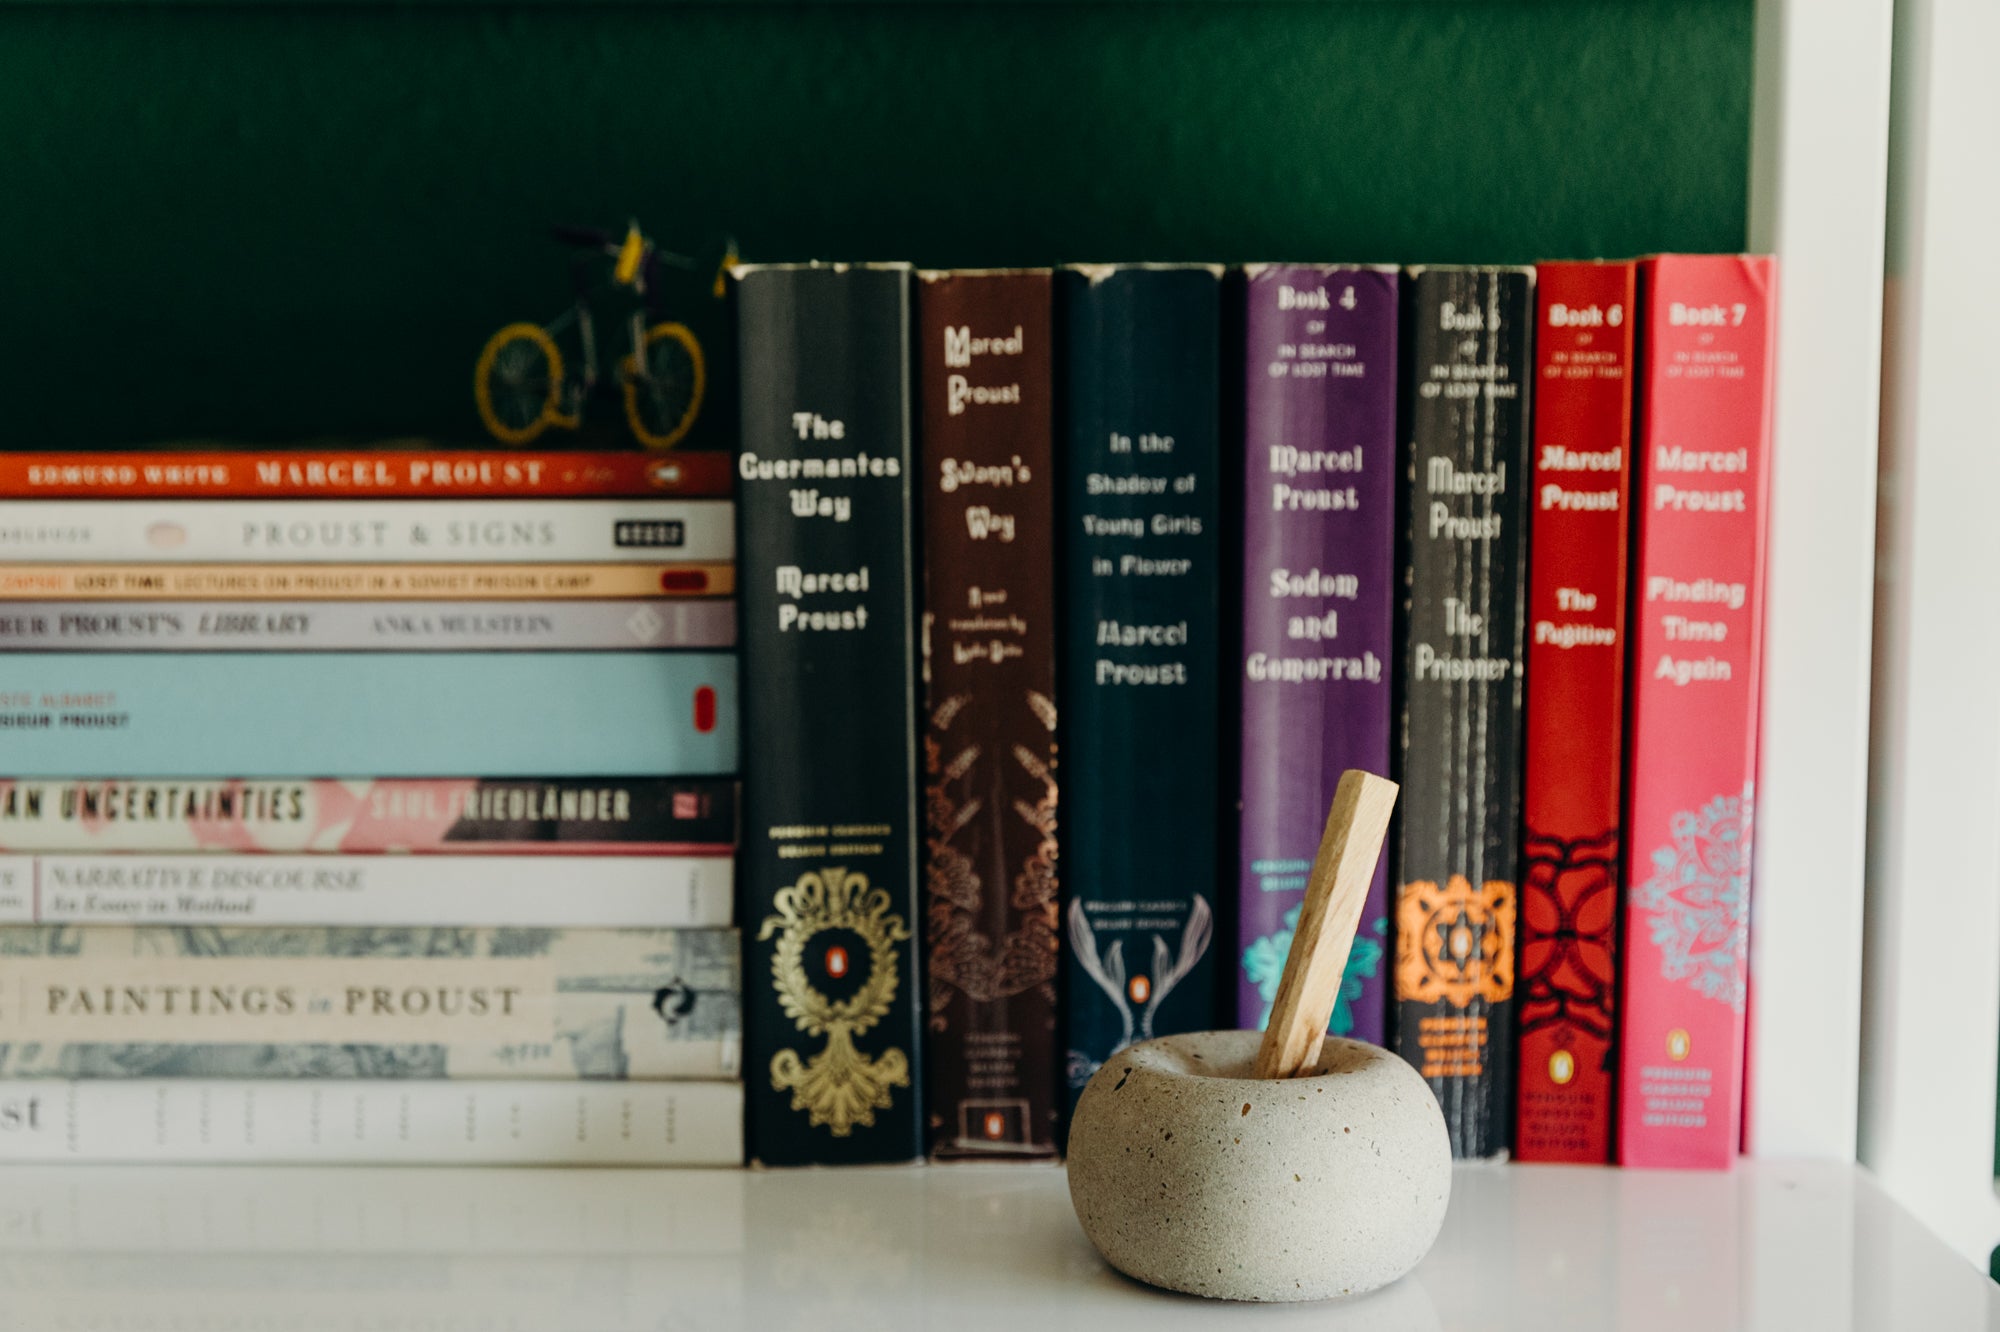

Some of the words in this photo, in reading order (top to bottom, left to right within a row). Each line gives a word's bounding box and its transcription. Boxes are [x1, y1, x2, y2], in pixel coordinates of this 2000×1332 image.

[1278, 286, 1331, 310] Book
[1339, 285, 1358, 311] 4
[1440, 301, 1484, 331] Book
[1548, 303, 1603, 327] Book
[1607, 303, 1624, 327] 6
[1668, 302, 1727, 326] Book
[1731, 303, 1747, 327] 7
[944, 324, 1023, 368] Marcel
[948, 374, 1020, 416] Proust
[792, 412, 845, 440] The
[1109, 432, 1132, 453] In
[1138, 432, 1175, 453] the
[739, 452, 900, 480] Guermantes
[1269, 445, 1363, 478] Marcel
[1539, 445, 1622, 471] Marcel
[1656, 445, 1748, 472] Marcel
[28, 464, 137, 486] EDMUND
[143, 464, 230, 486] WHITE
[254, 460, 398, 487] MARCEL
[409, 460, 547, 486] PROUST
[1086, 472, 1167, 495] Shadow
[1173, 472, 1196, 494] of
[1426, 456, 1506, 494] Marcel
[789, 488, 851, 522] Way
[1272, 484, 1360, 511] Proust
[1540, 484, 1619, 510] Proust
[1654, 484, 1747, 511] Proust
[242, 521, 390, 547] PROUST
[410, 522, 432, 546] &
[448, 520, 557, 547] SIGNS
[965, 505, 1016, 543] Way
[1083, 514, 1145, 538] Young
[1150, 513, 1202, 536] Girls
[1429, 501, 1502, 540] Proust
[1092, 555, 1114, 576] in
[1120, 554, 1191, 576] Flower
[776, 565, 869, 599] Marcel
[1270, 567, 1359, 600] Sodom
[1648, 575, 1747, 610] Finding
[1556, 587, 1598, 611] The
[58, 611, 184, 636] PROUST'S
[198, 611, 312, 636] LIBRARY
[778, 603, 868, 632] Proust
[1288, 609, 1338, 642] and
[1443, 597, 1483, 636] The
[1661, 614, 1728, 642] Time
[1096, 620, 1188, 646] Marcel
[1535, 620, 1617, 649] Fugitive
[1096, 658, 1188, 685] Proust
[1247, 651, 1382, 683] Gomorrah
[1415, 642, 1511, 680] Prisoner
[1655, 654, 1733, 686] Again
[60, 786, 306, 820] UNCERTAINTIES
[51, 867, 204, 889] NARRATIVE
[211, 867, 366, 890] DISCOURSE
[47, 984, 298, 1015] PAINTINGS
[344, 984, 523, 1016] PROUST
